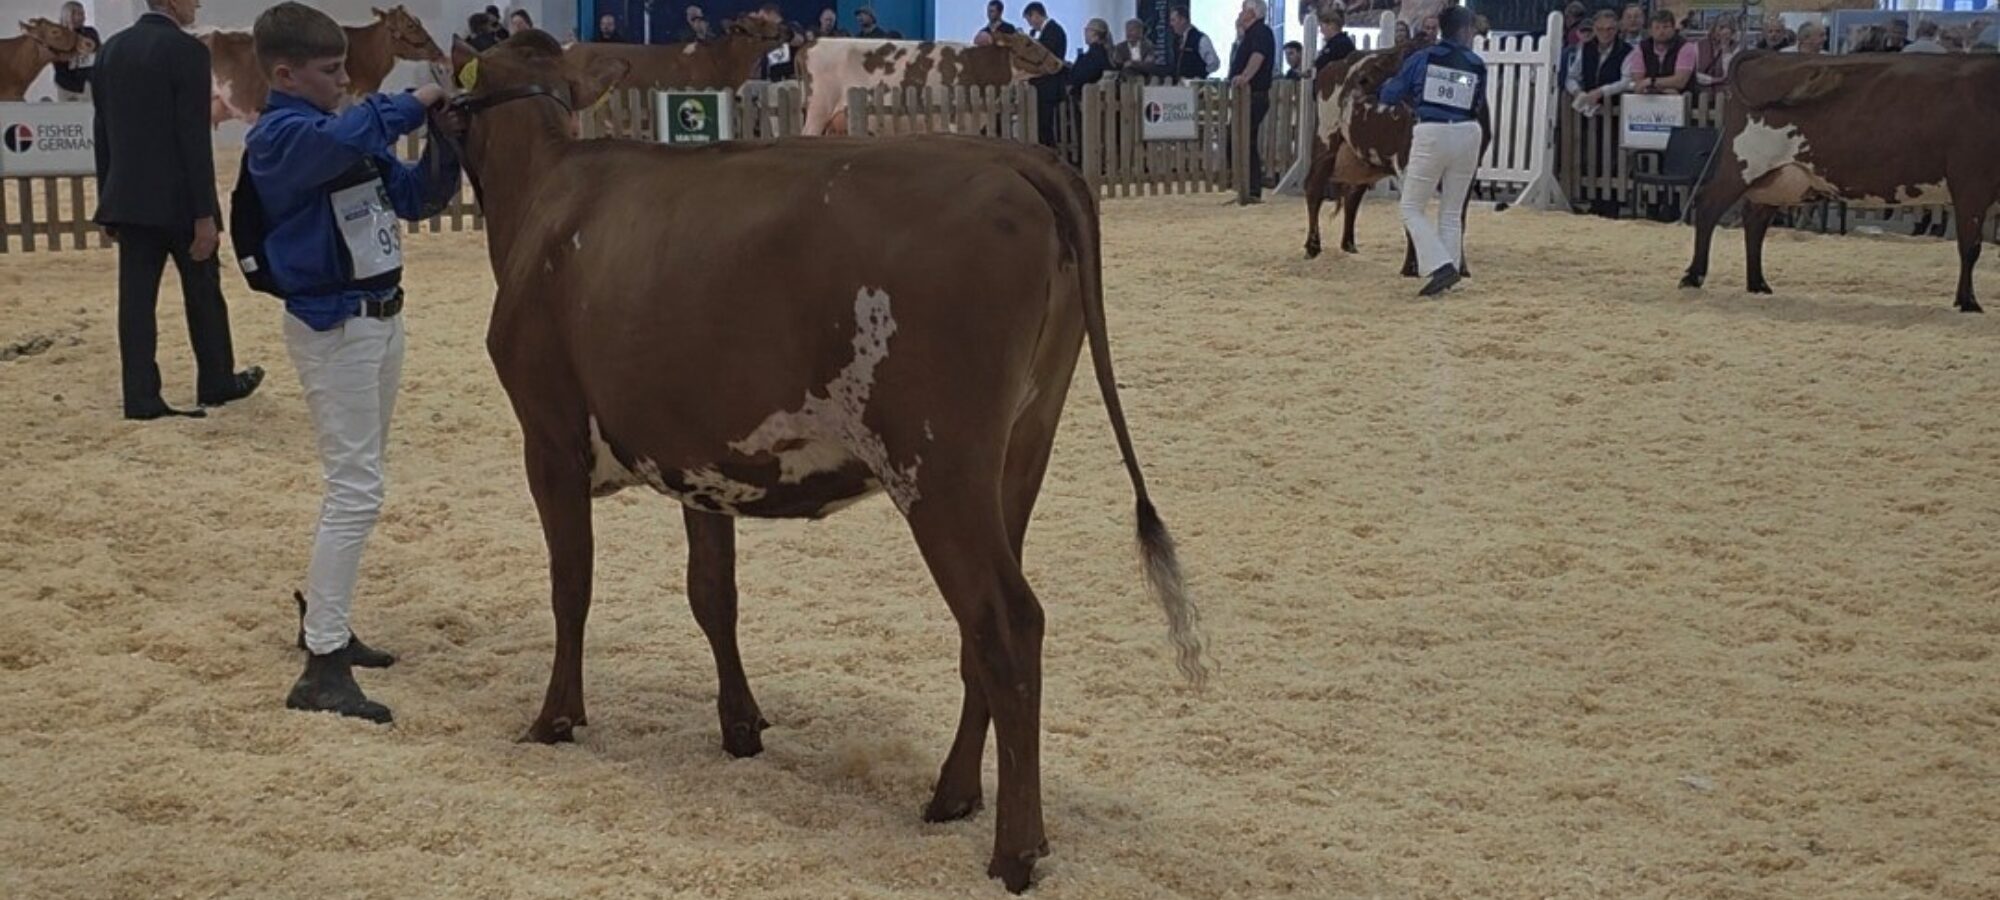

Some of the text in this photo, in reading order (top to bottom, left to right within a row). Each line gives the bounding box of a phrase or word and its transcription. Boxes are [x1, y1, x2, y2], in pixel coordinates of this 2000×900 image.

[1437, 85, 1455, 99] 98
[37, 124, 83, 137] FISHER
[38, 138, 95, 151] GERMAN
